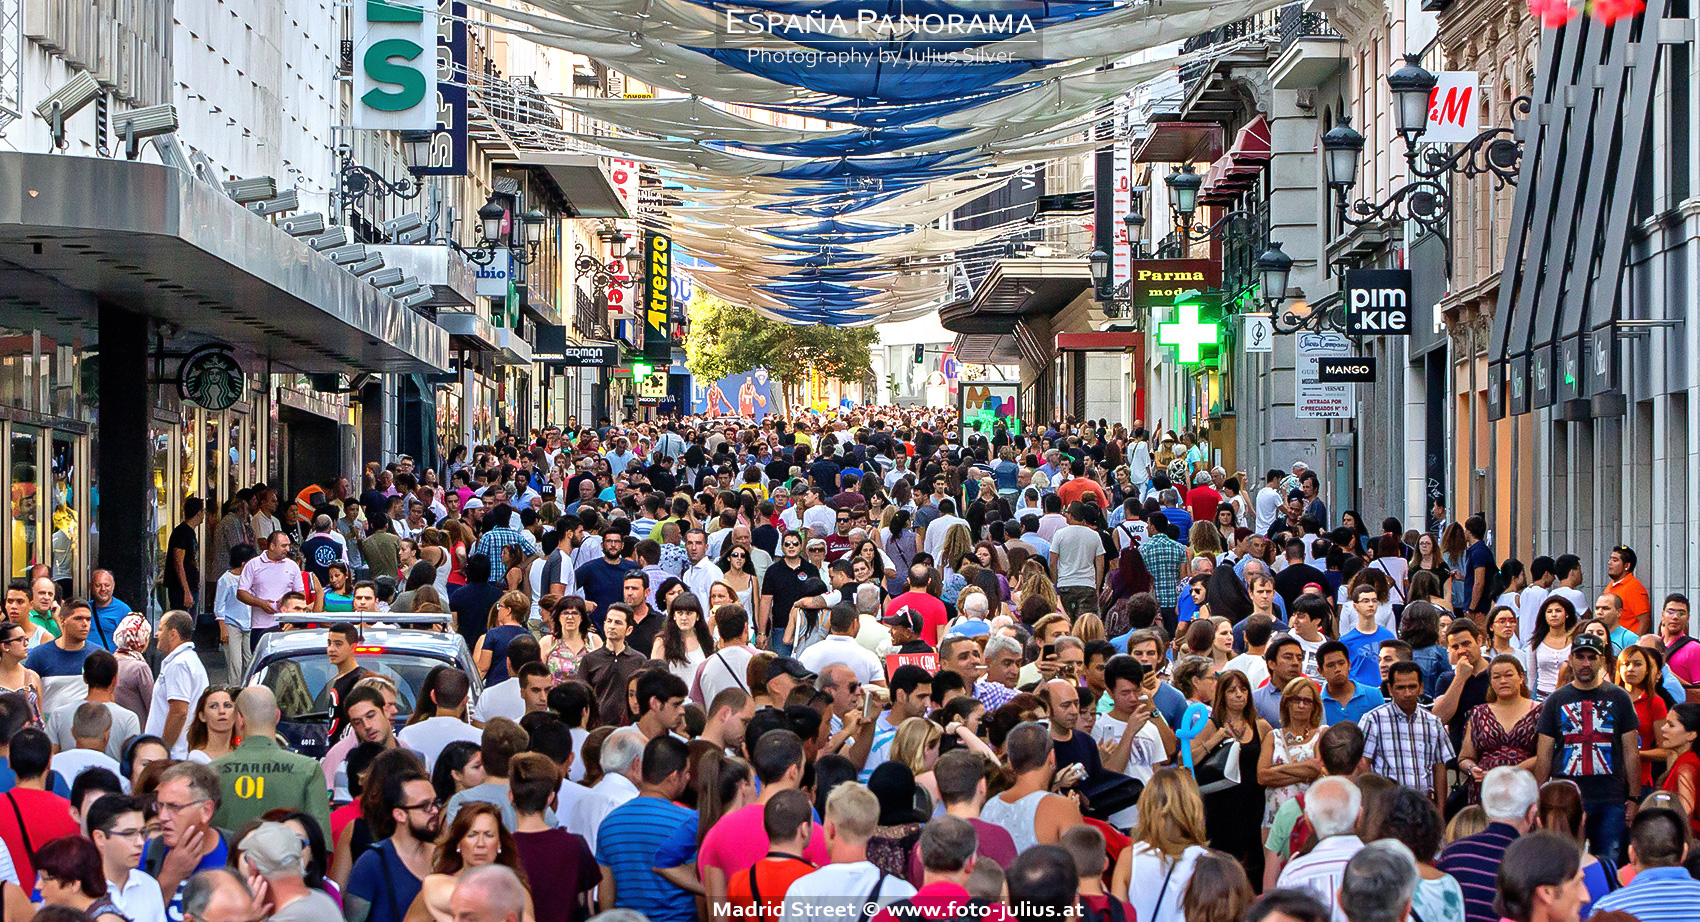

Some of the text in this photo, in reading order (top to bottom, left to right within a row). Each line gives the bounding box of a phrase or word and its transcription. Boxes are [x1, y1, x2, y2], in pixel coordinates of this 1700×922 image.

[1138, 270, 1204, 281] Parma
[1149, 288, 1193, 296] mod
[1351, 288, 1406, 314] pim
[1326, 366, 1369, 374] MANGO
[301, 738, 315, 746] 6012
